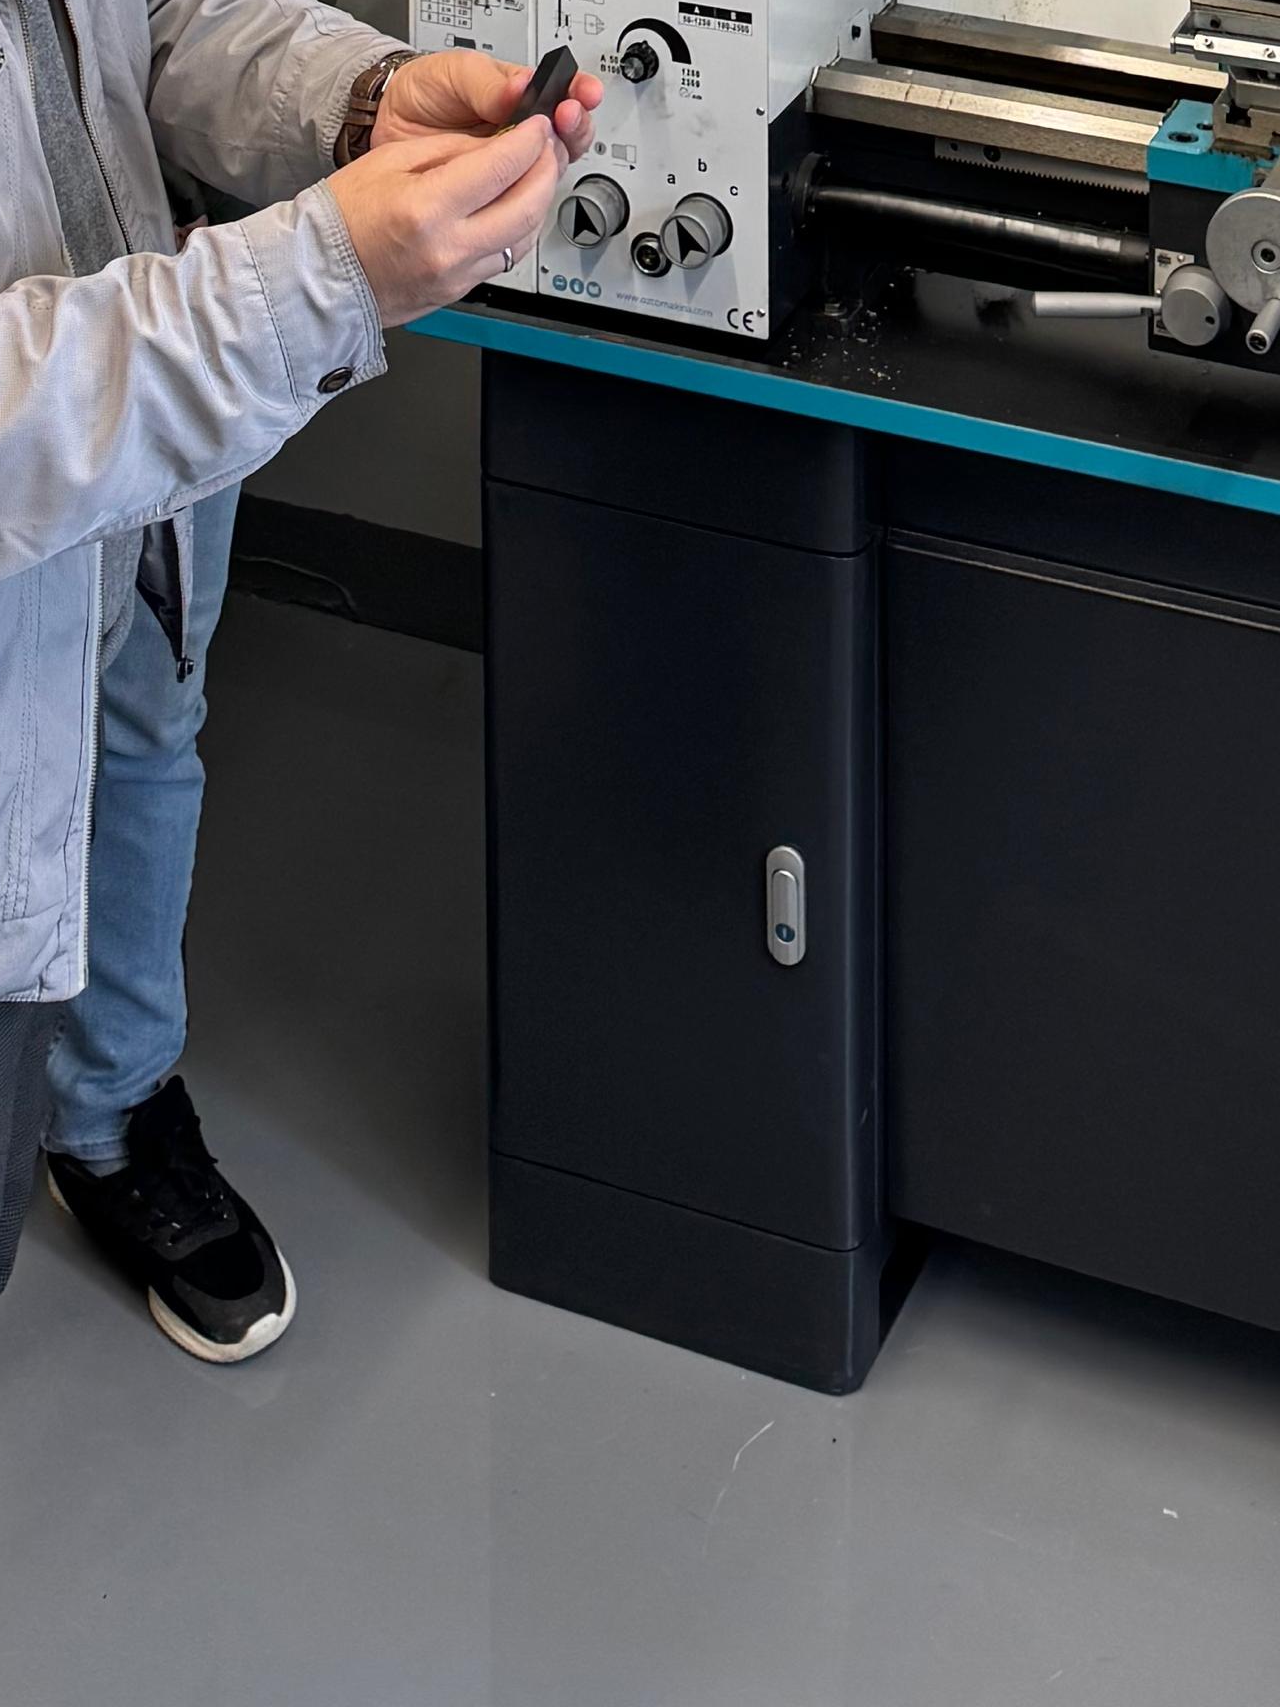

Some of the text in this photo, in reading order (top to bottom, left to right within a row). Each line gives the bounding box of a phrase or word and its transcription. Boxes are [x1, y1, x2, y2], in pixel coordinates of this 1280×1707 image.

[697, 158, 708, 172] b
[666, 173, 676, 185] a
[729, 185, 739, 196] c
